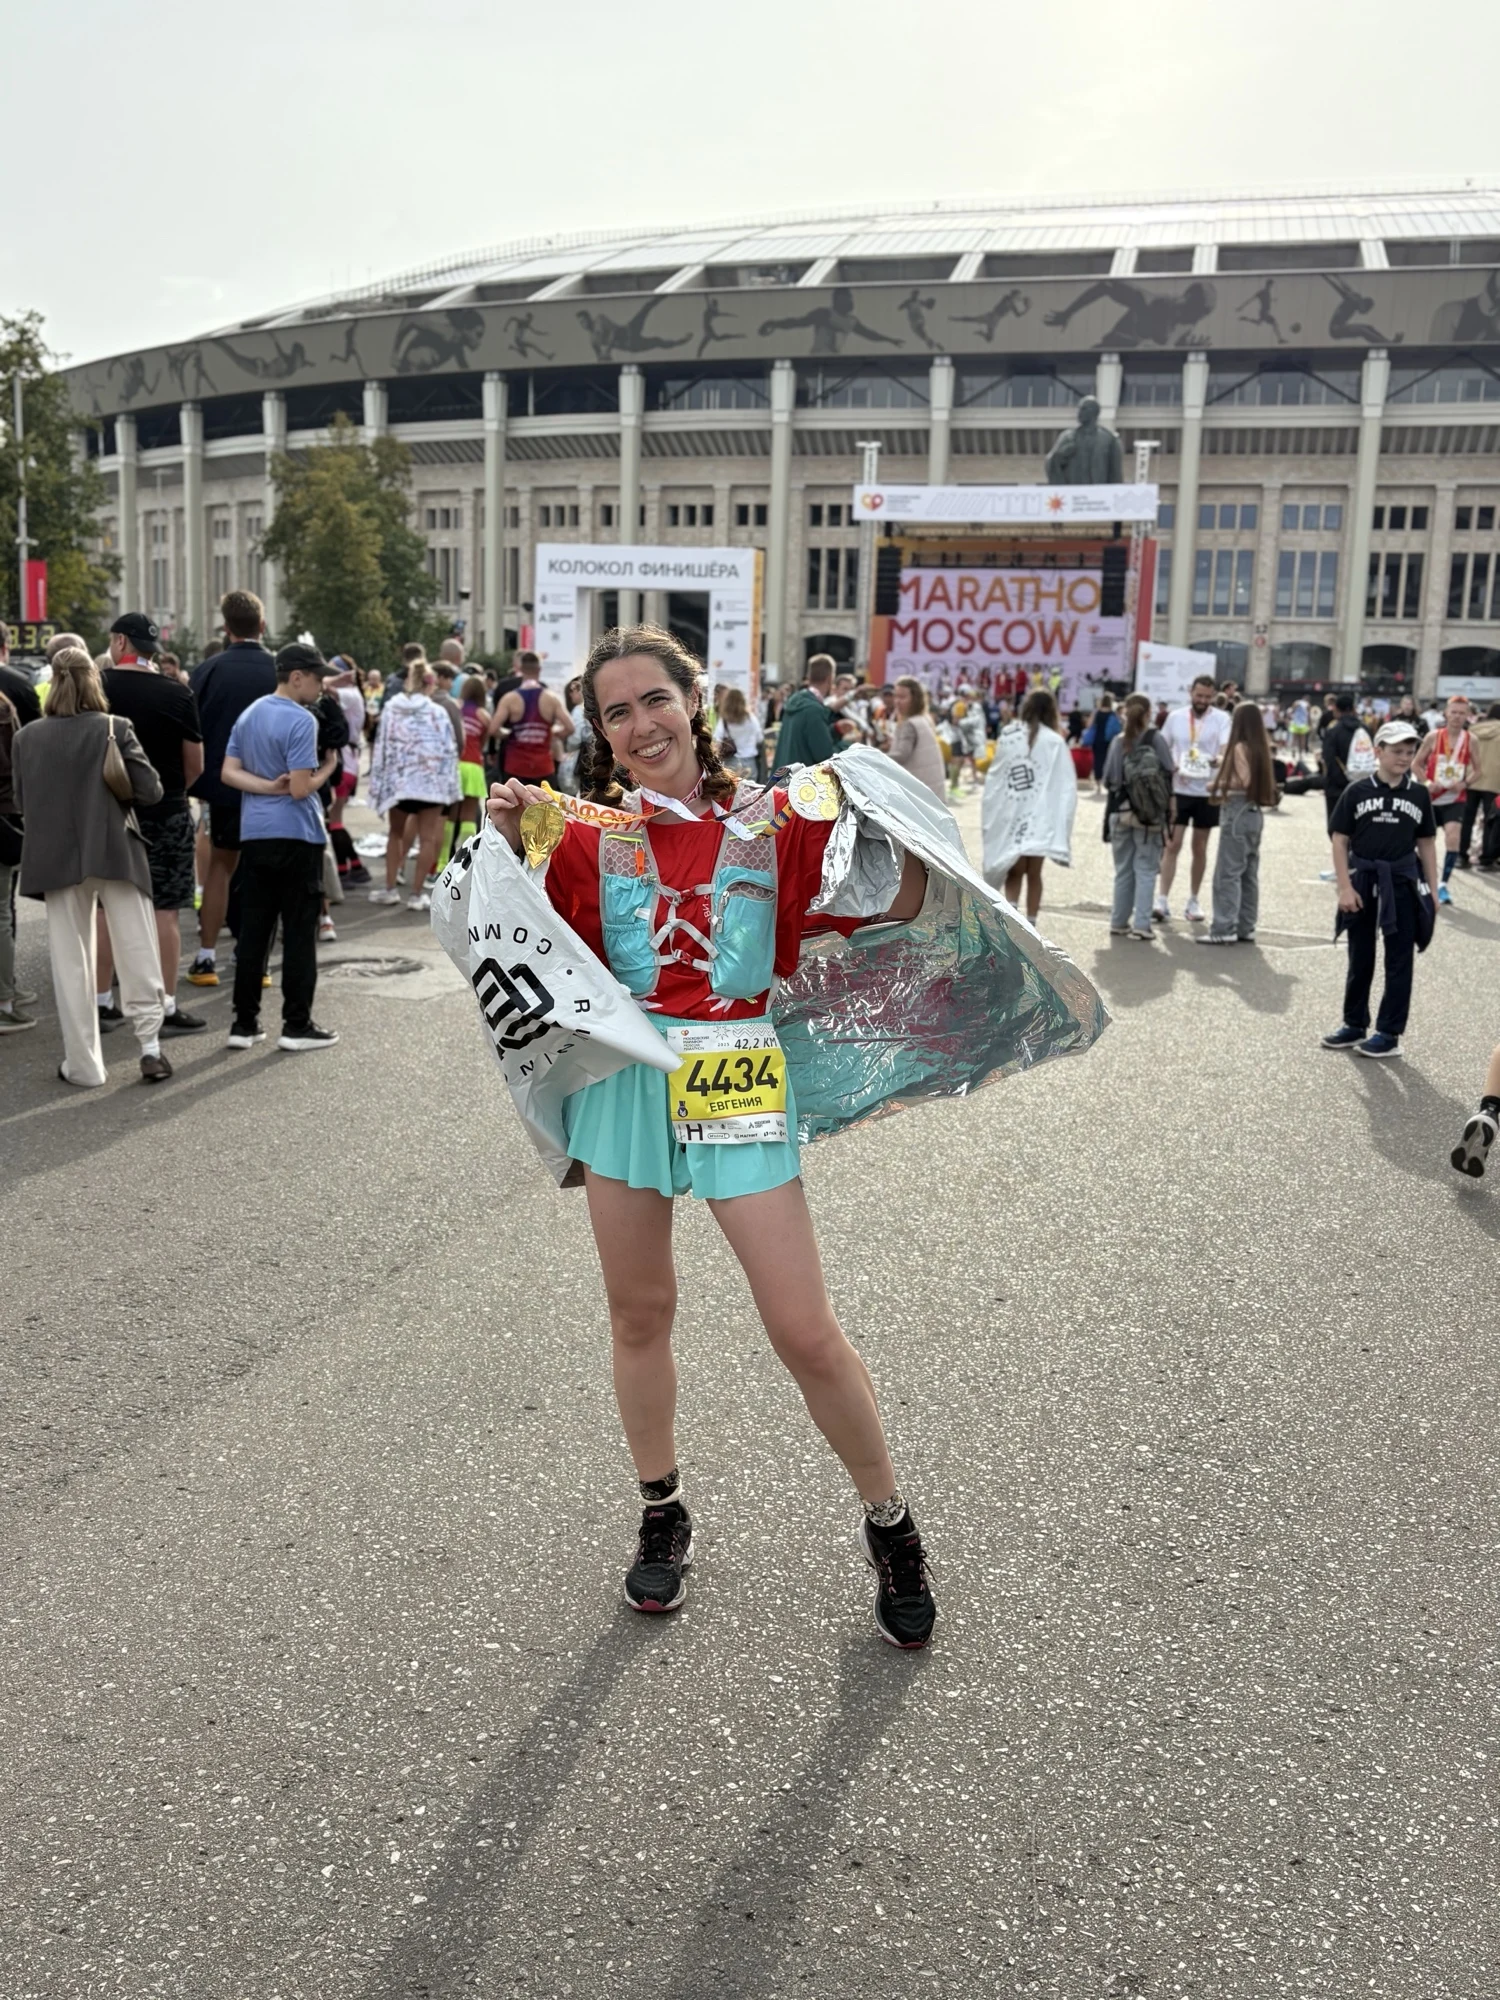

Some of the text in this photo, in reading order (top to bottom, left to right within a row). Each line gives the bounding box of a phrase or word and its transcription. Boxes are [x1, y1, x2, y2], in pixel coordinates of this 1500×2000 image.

[548, 559, 740, 579] КОЛОКОЛ ФИНИШЁРА
[897, 575, 1102, 614] MARATHO
[888, 618, 1080, 655] MOSCOW
[565, 799, 635, 832] АФОН
[468, 923, 553, 955] COMM
[734, 1038, 760, 1051] 42,2
[686, 1055, 779, 1097] 4434
[709, 1096, 763, 1112] ЕВГЕНИЯ
